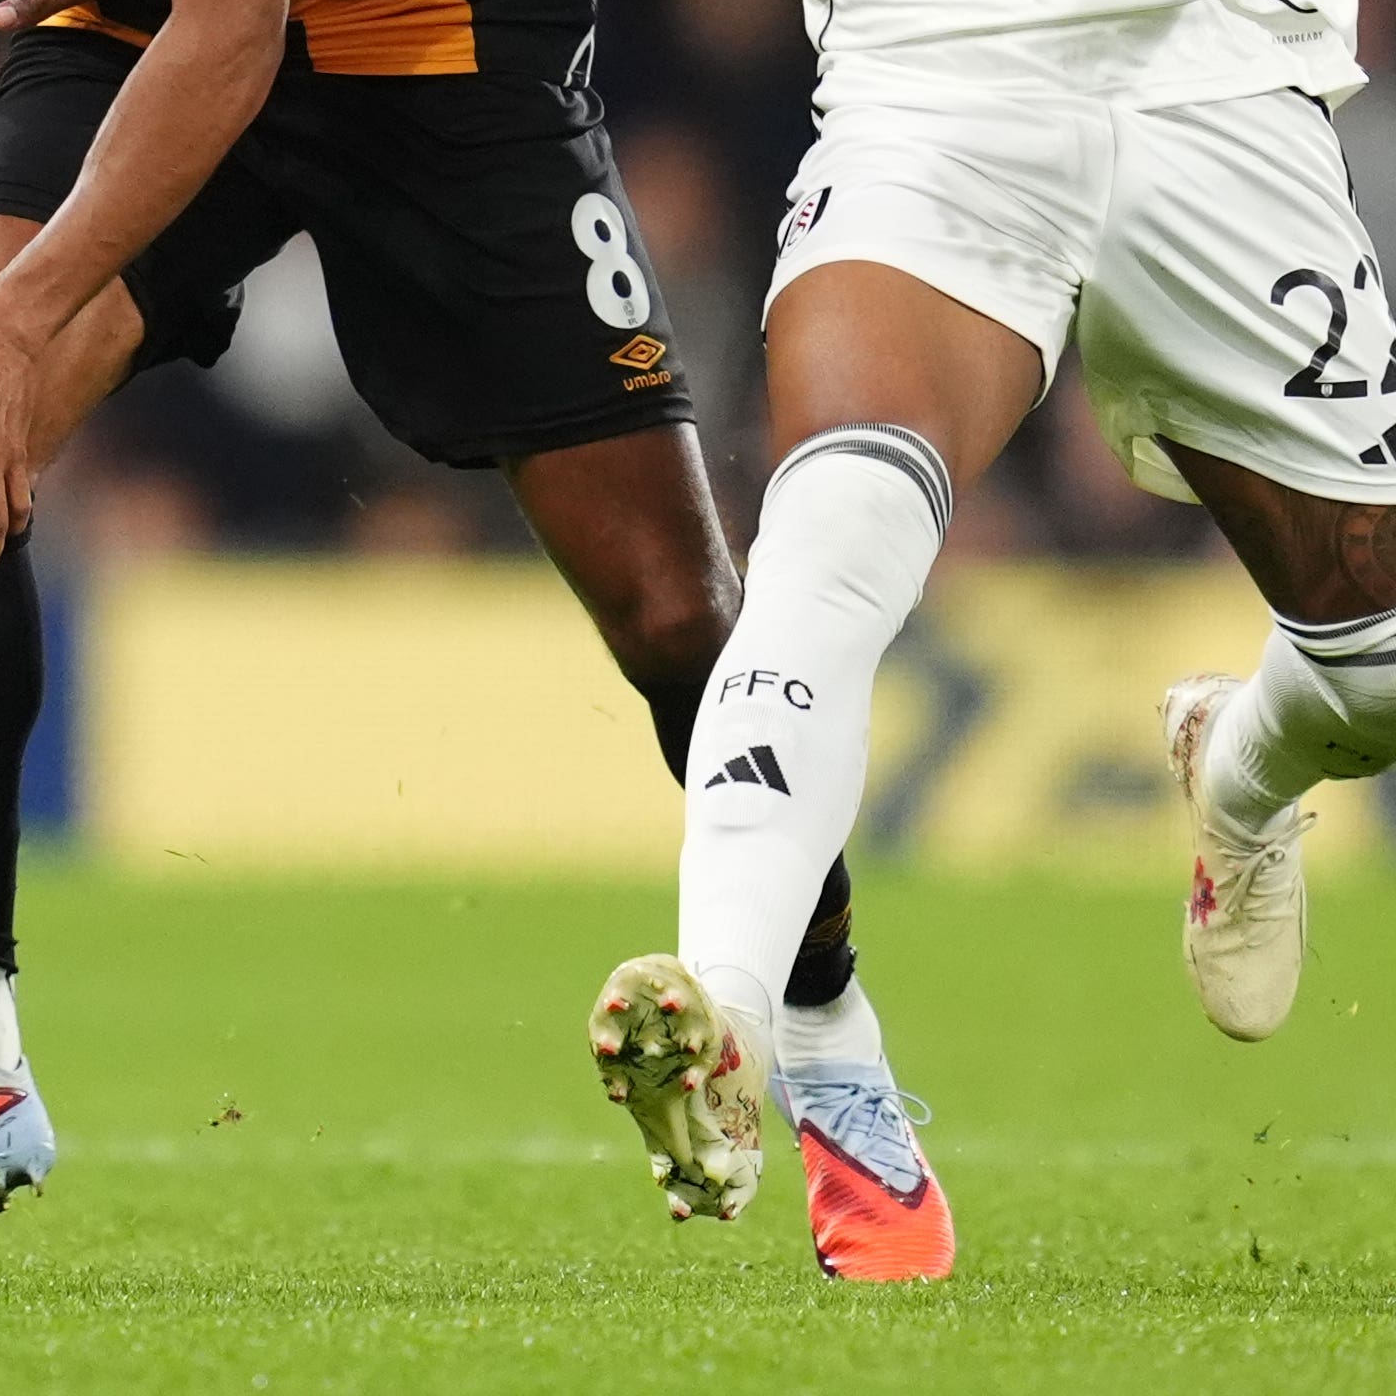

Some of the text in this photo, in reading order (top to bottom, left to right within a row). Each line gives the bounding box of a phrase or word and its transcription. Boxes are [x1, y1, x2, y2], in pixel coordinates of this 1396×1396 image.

[570, 191, 651, 330] 8
[622, 370, 672, 392] umbro
[718, 669, 814, 711] FFC
